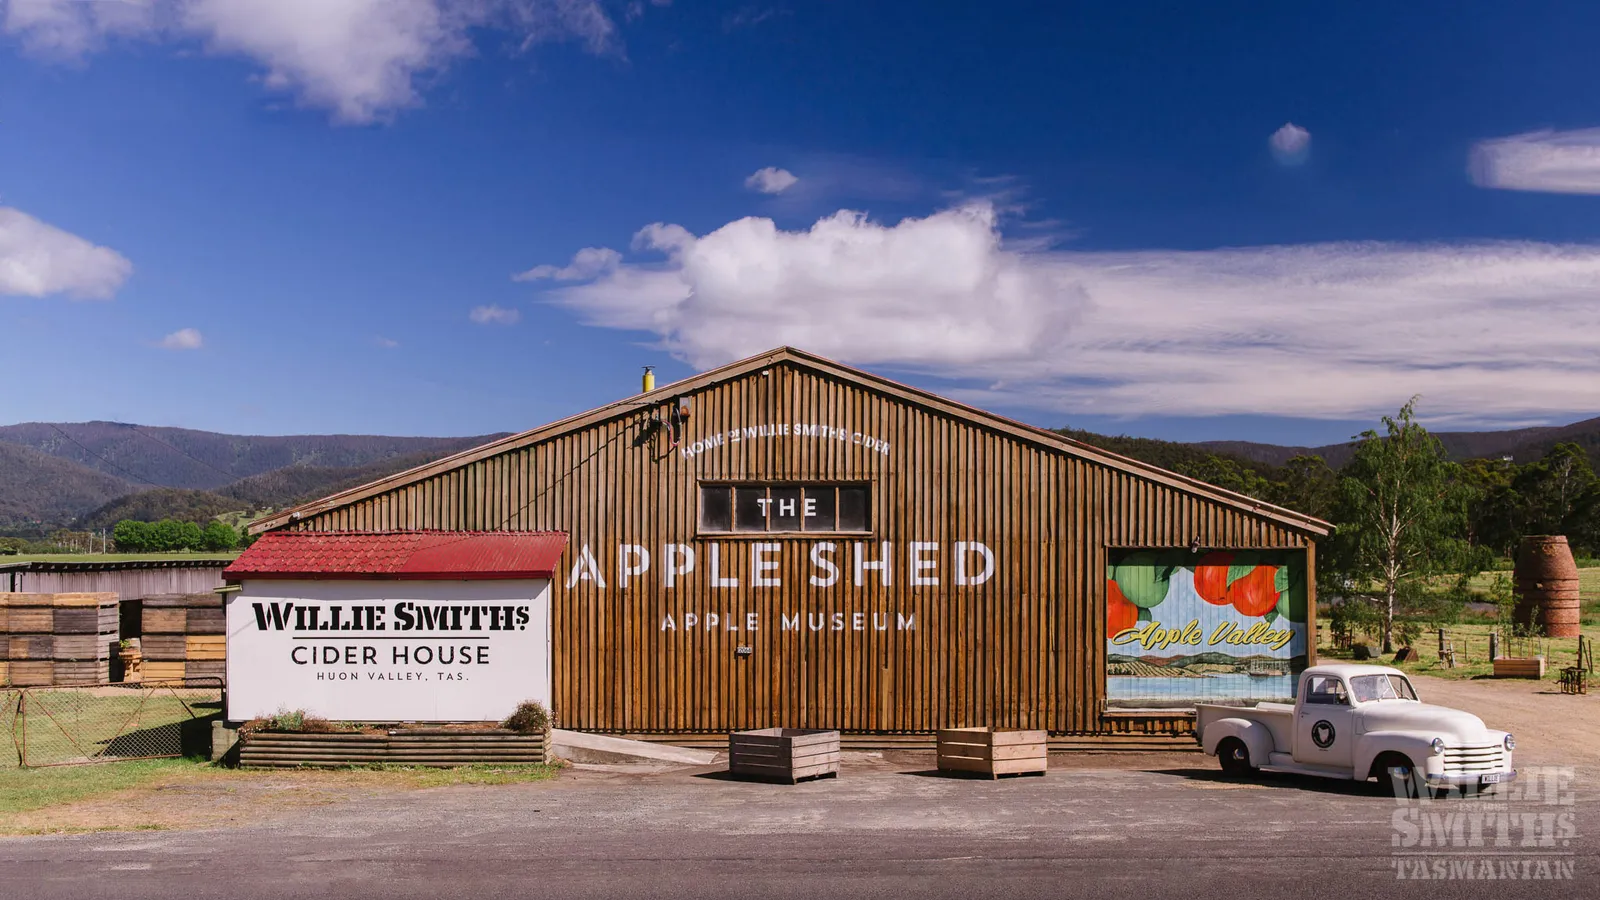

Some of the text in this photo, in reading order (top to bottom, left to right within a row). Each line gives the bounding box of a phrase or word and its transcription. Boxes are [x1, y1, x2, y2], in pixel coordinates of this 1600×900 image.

[681, 422, 891, 459] HOME OF WILLIE SMITHS CIDER
[757, 498, 817, 517] THE
[566, 541, 996, 589] APPLE SHED
[252, 602, 386, 631] WILLIE
[661, 611, 918, 632] APPLE MUSEUM
[1111, 618, 1295, 651] Apple Valley
[291, 646, 490, 665] CIDER HOUSE
[316, 671, 470, 682] HUON VALLEY, TAS.
